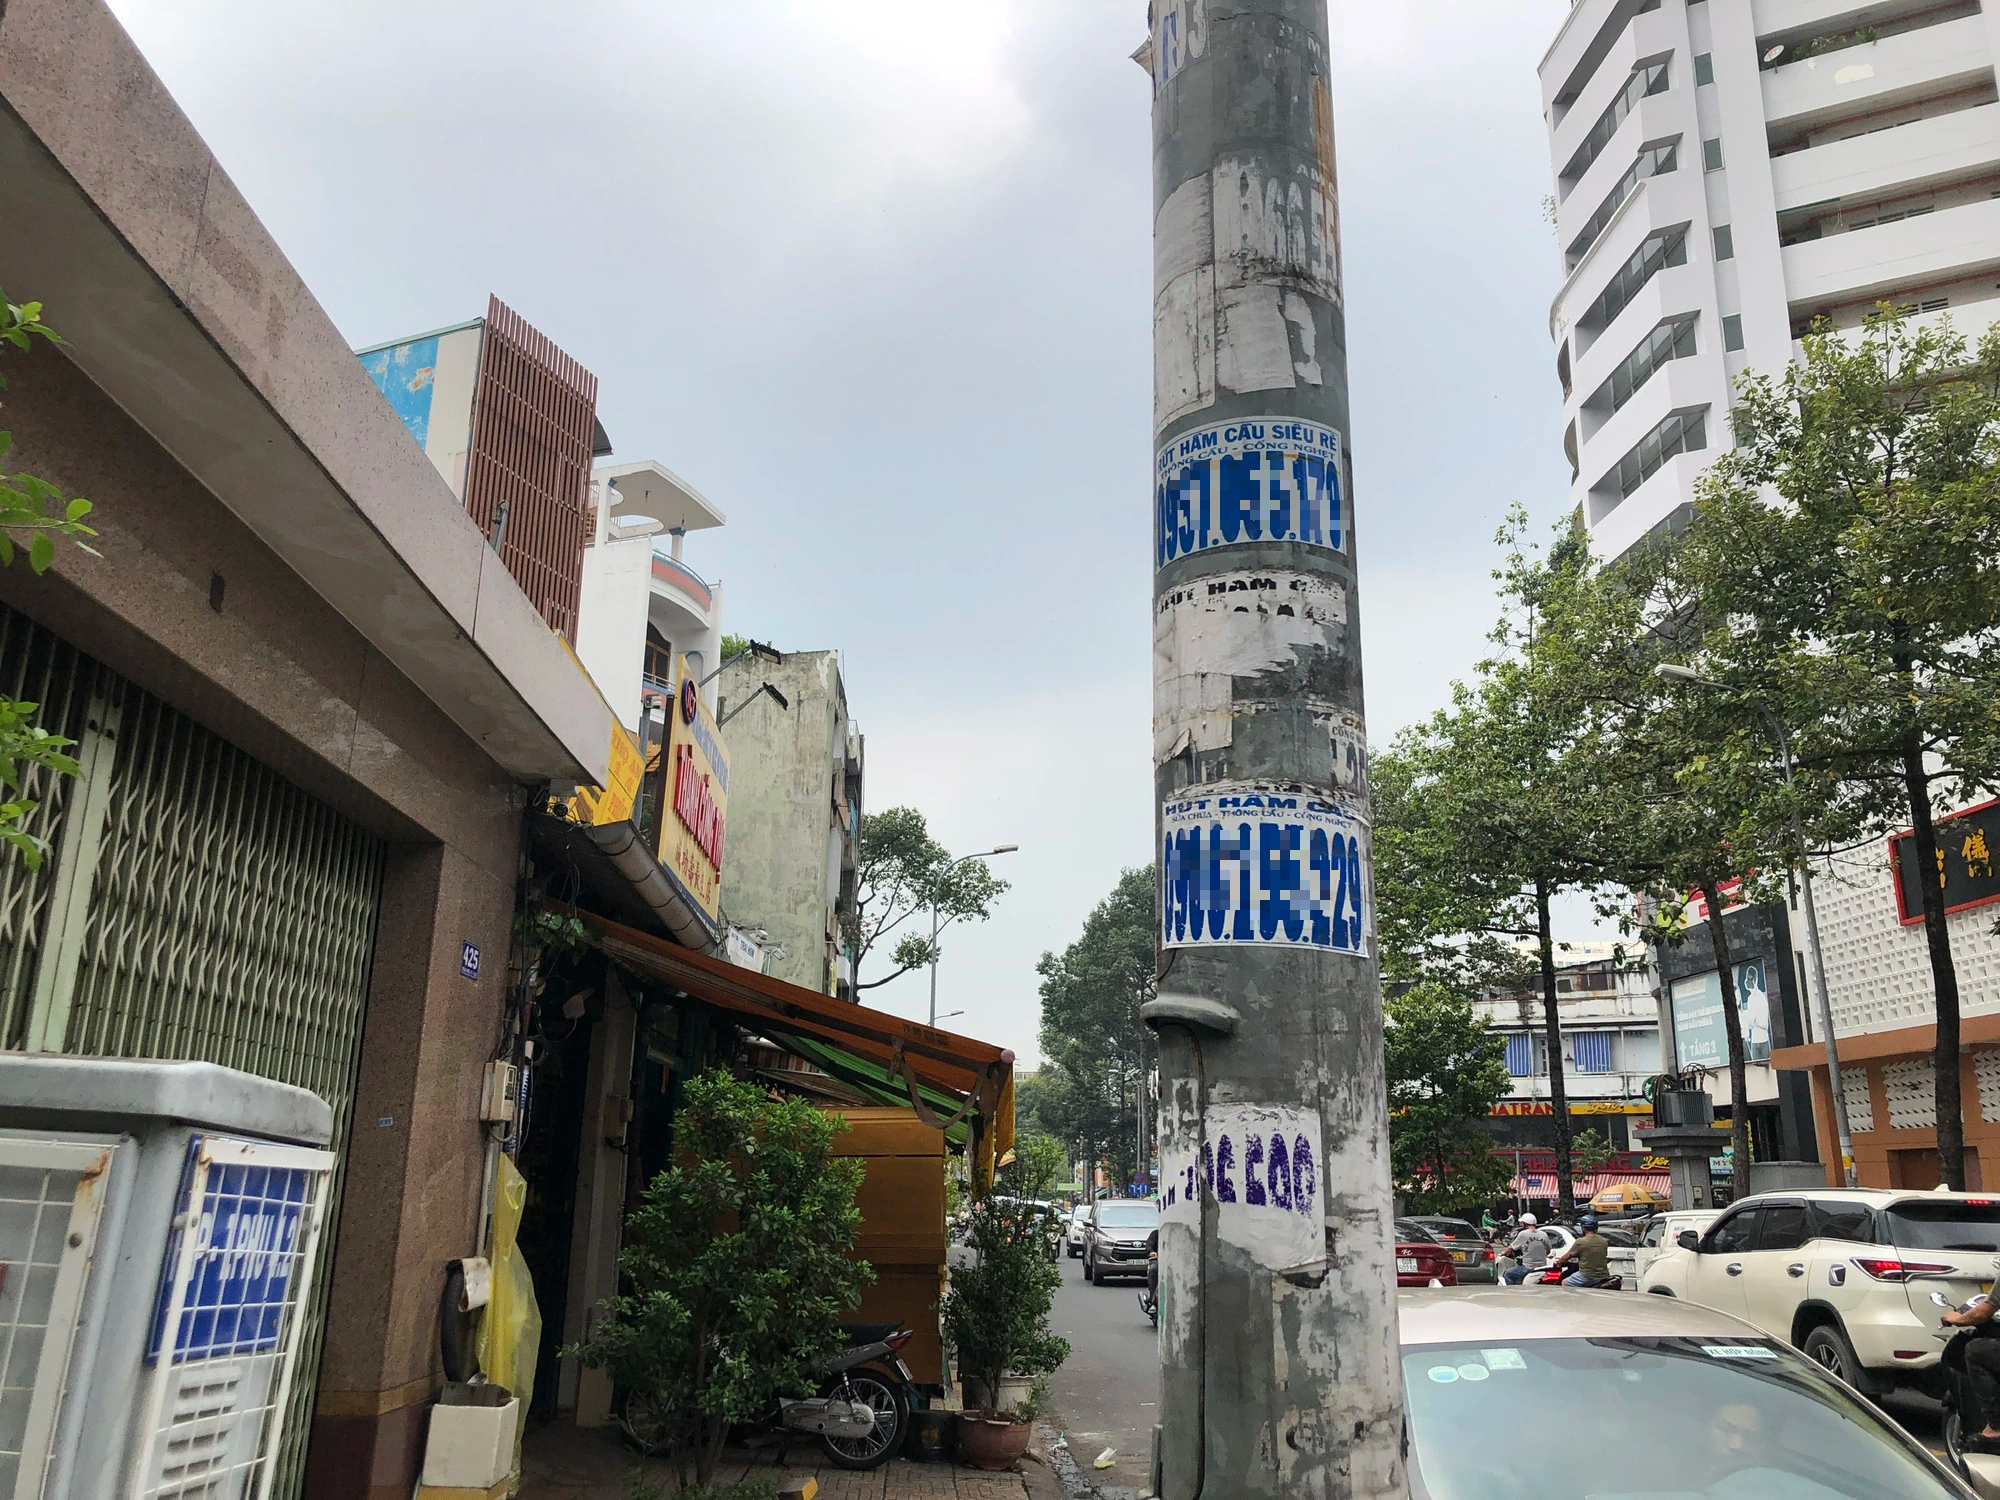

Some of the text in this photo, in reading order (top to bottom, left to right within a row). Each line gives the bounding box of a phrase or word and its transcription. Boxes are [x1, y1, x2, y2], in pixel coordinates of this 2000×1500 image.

[1272, 423, 1314, 444] SIÊU
[463, 945, 479, 970] 425
[1710, 1041, 1717, 1054] 3
